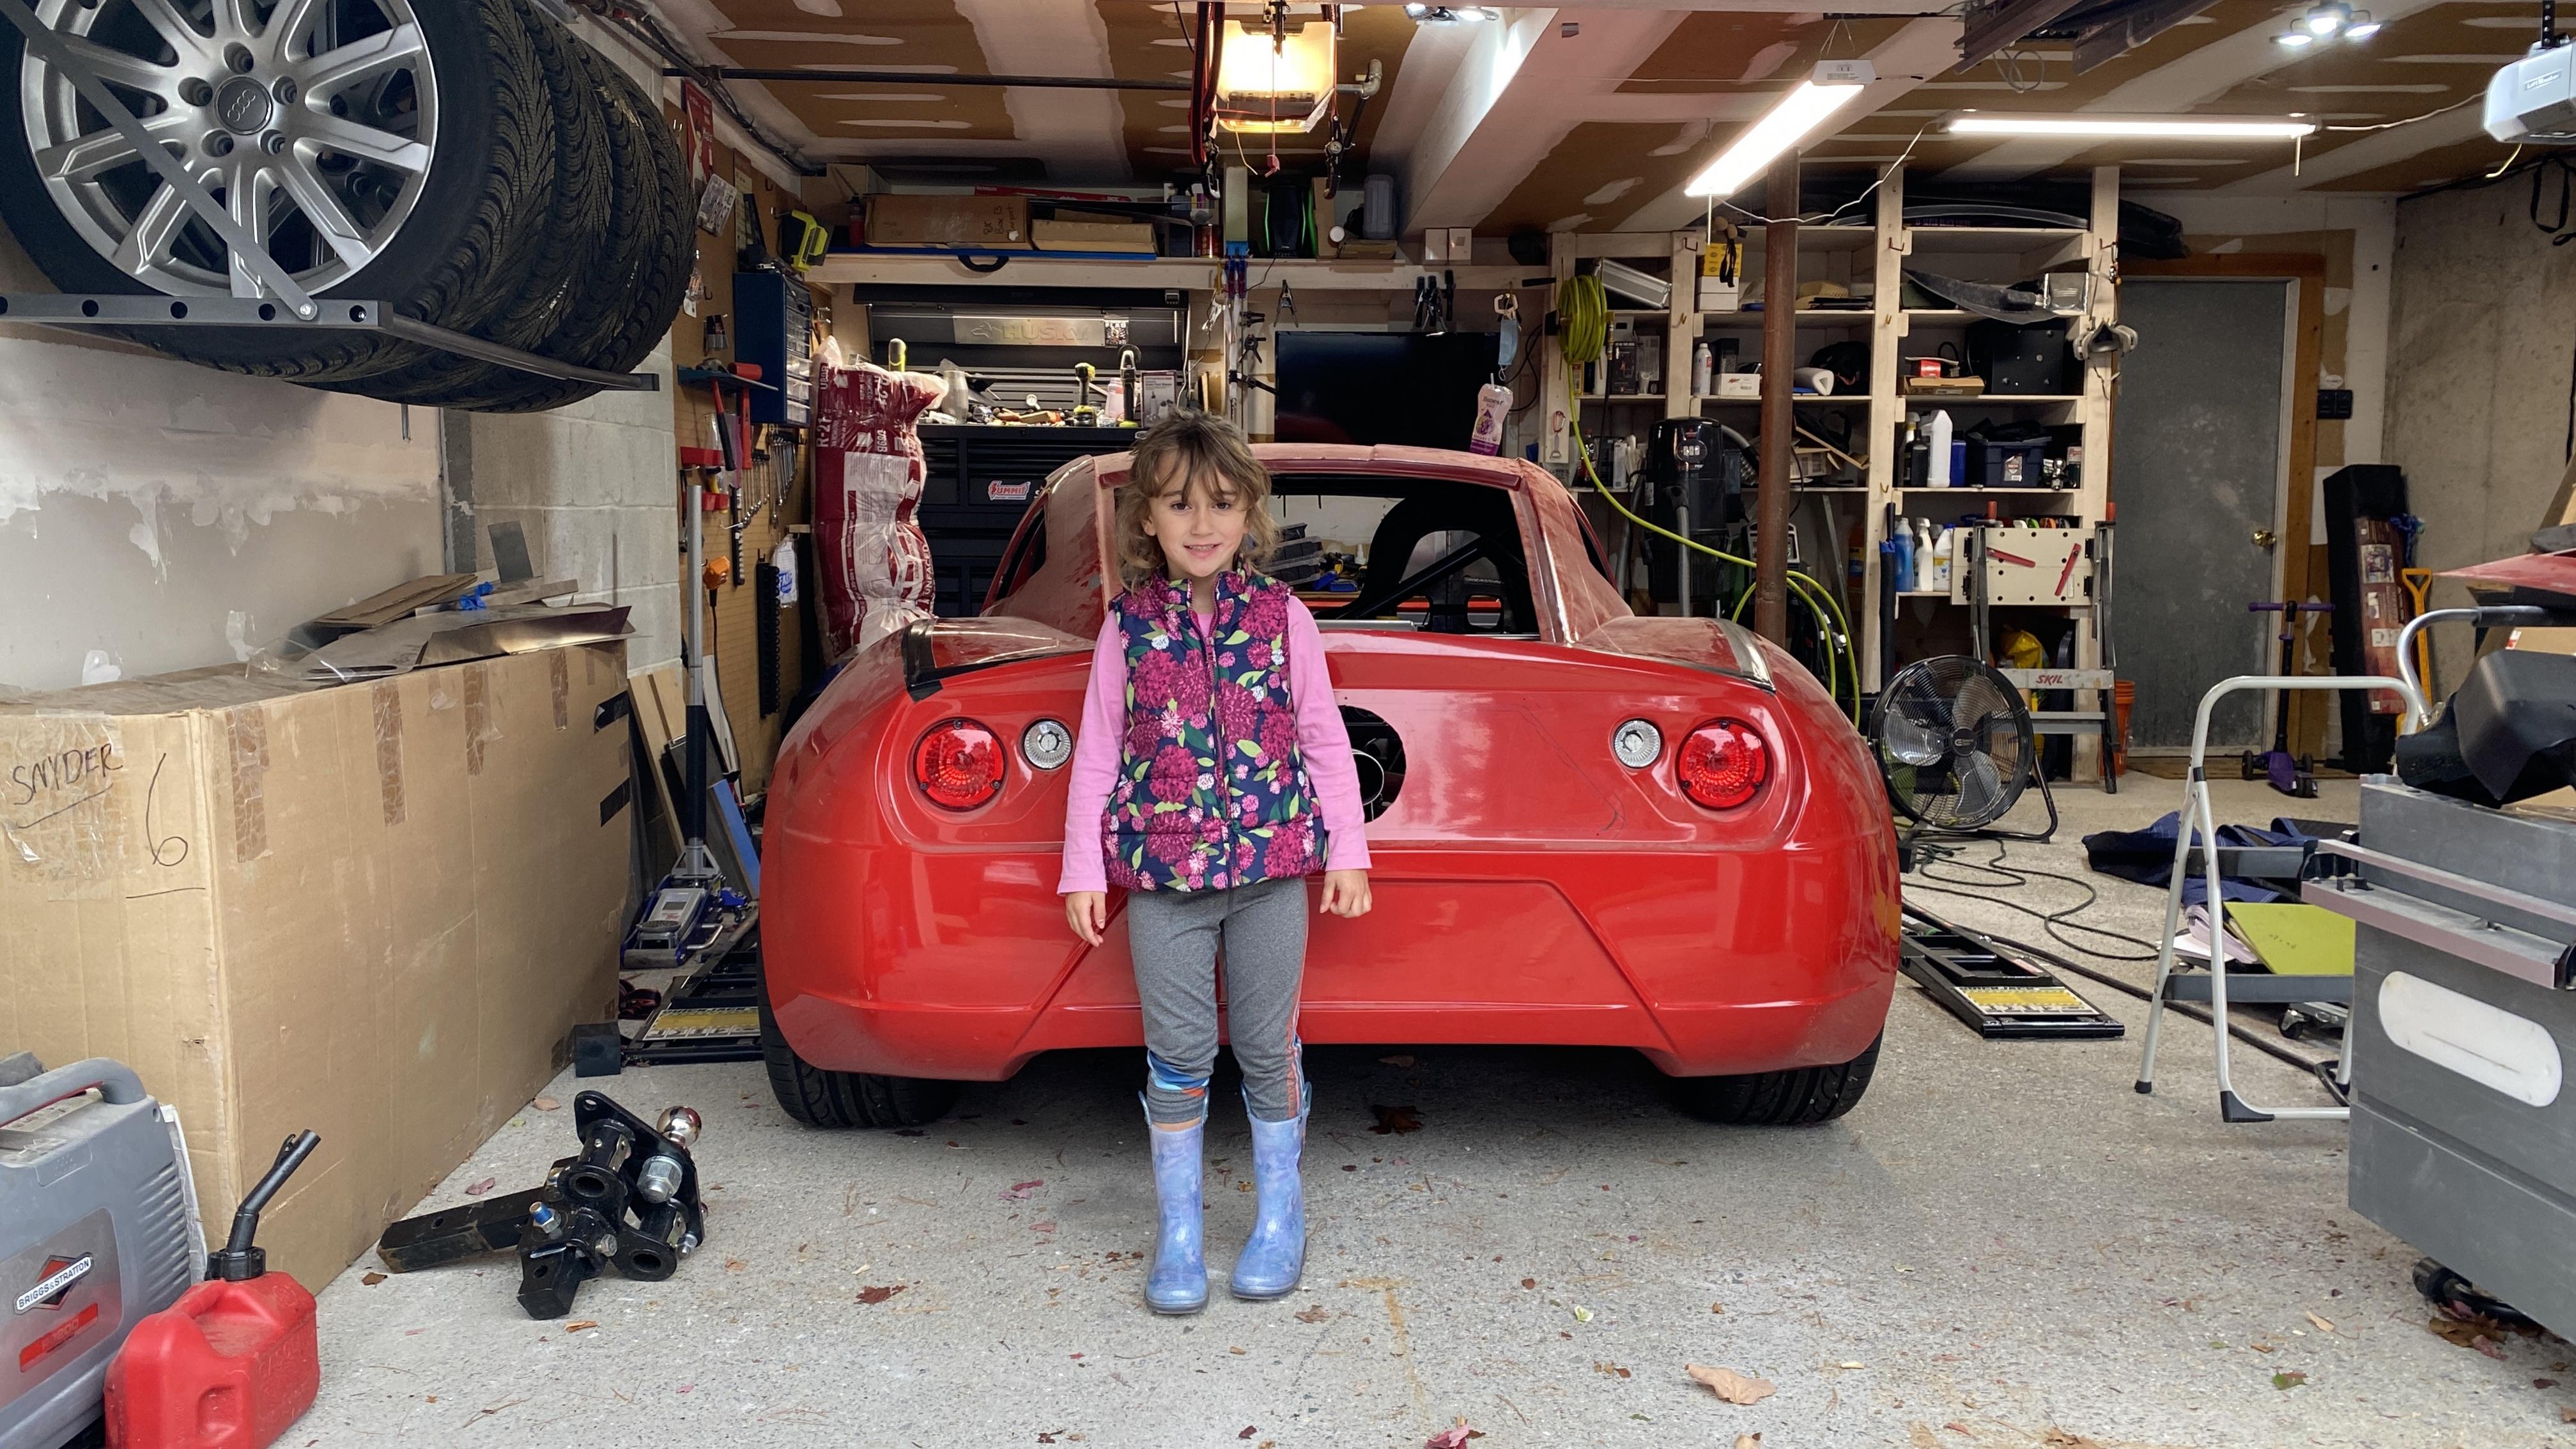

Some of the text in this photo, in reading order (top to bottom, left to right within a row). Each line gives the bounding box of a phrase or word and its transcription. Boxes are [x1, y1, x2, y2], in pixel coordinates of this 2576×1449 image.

[1001, 323, 1090, 341] HUSKY
[990, 481, 1028, 495] SUMMIT
[922, 544, 933, 595] UNFACED
[2035, 674, 2063, 686] SKIL
[12, 743, 125, 806] SNYDER
[145, 752, 189, 867] 6
